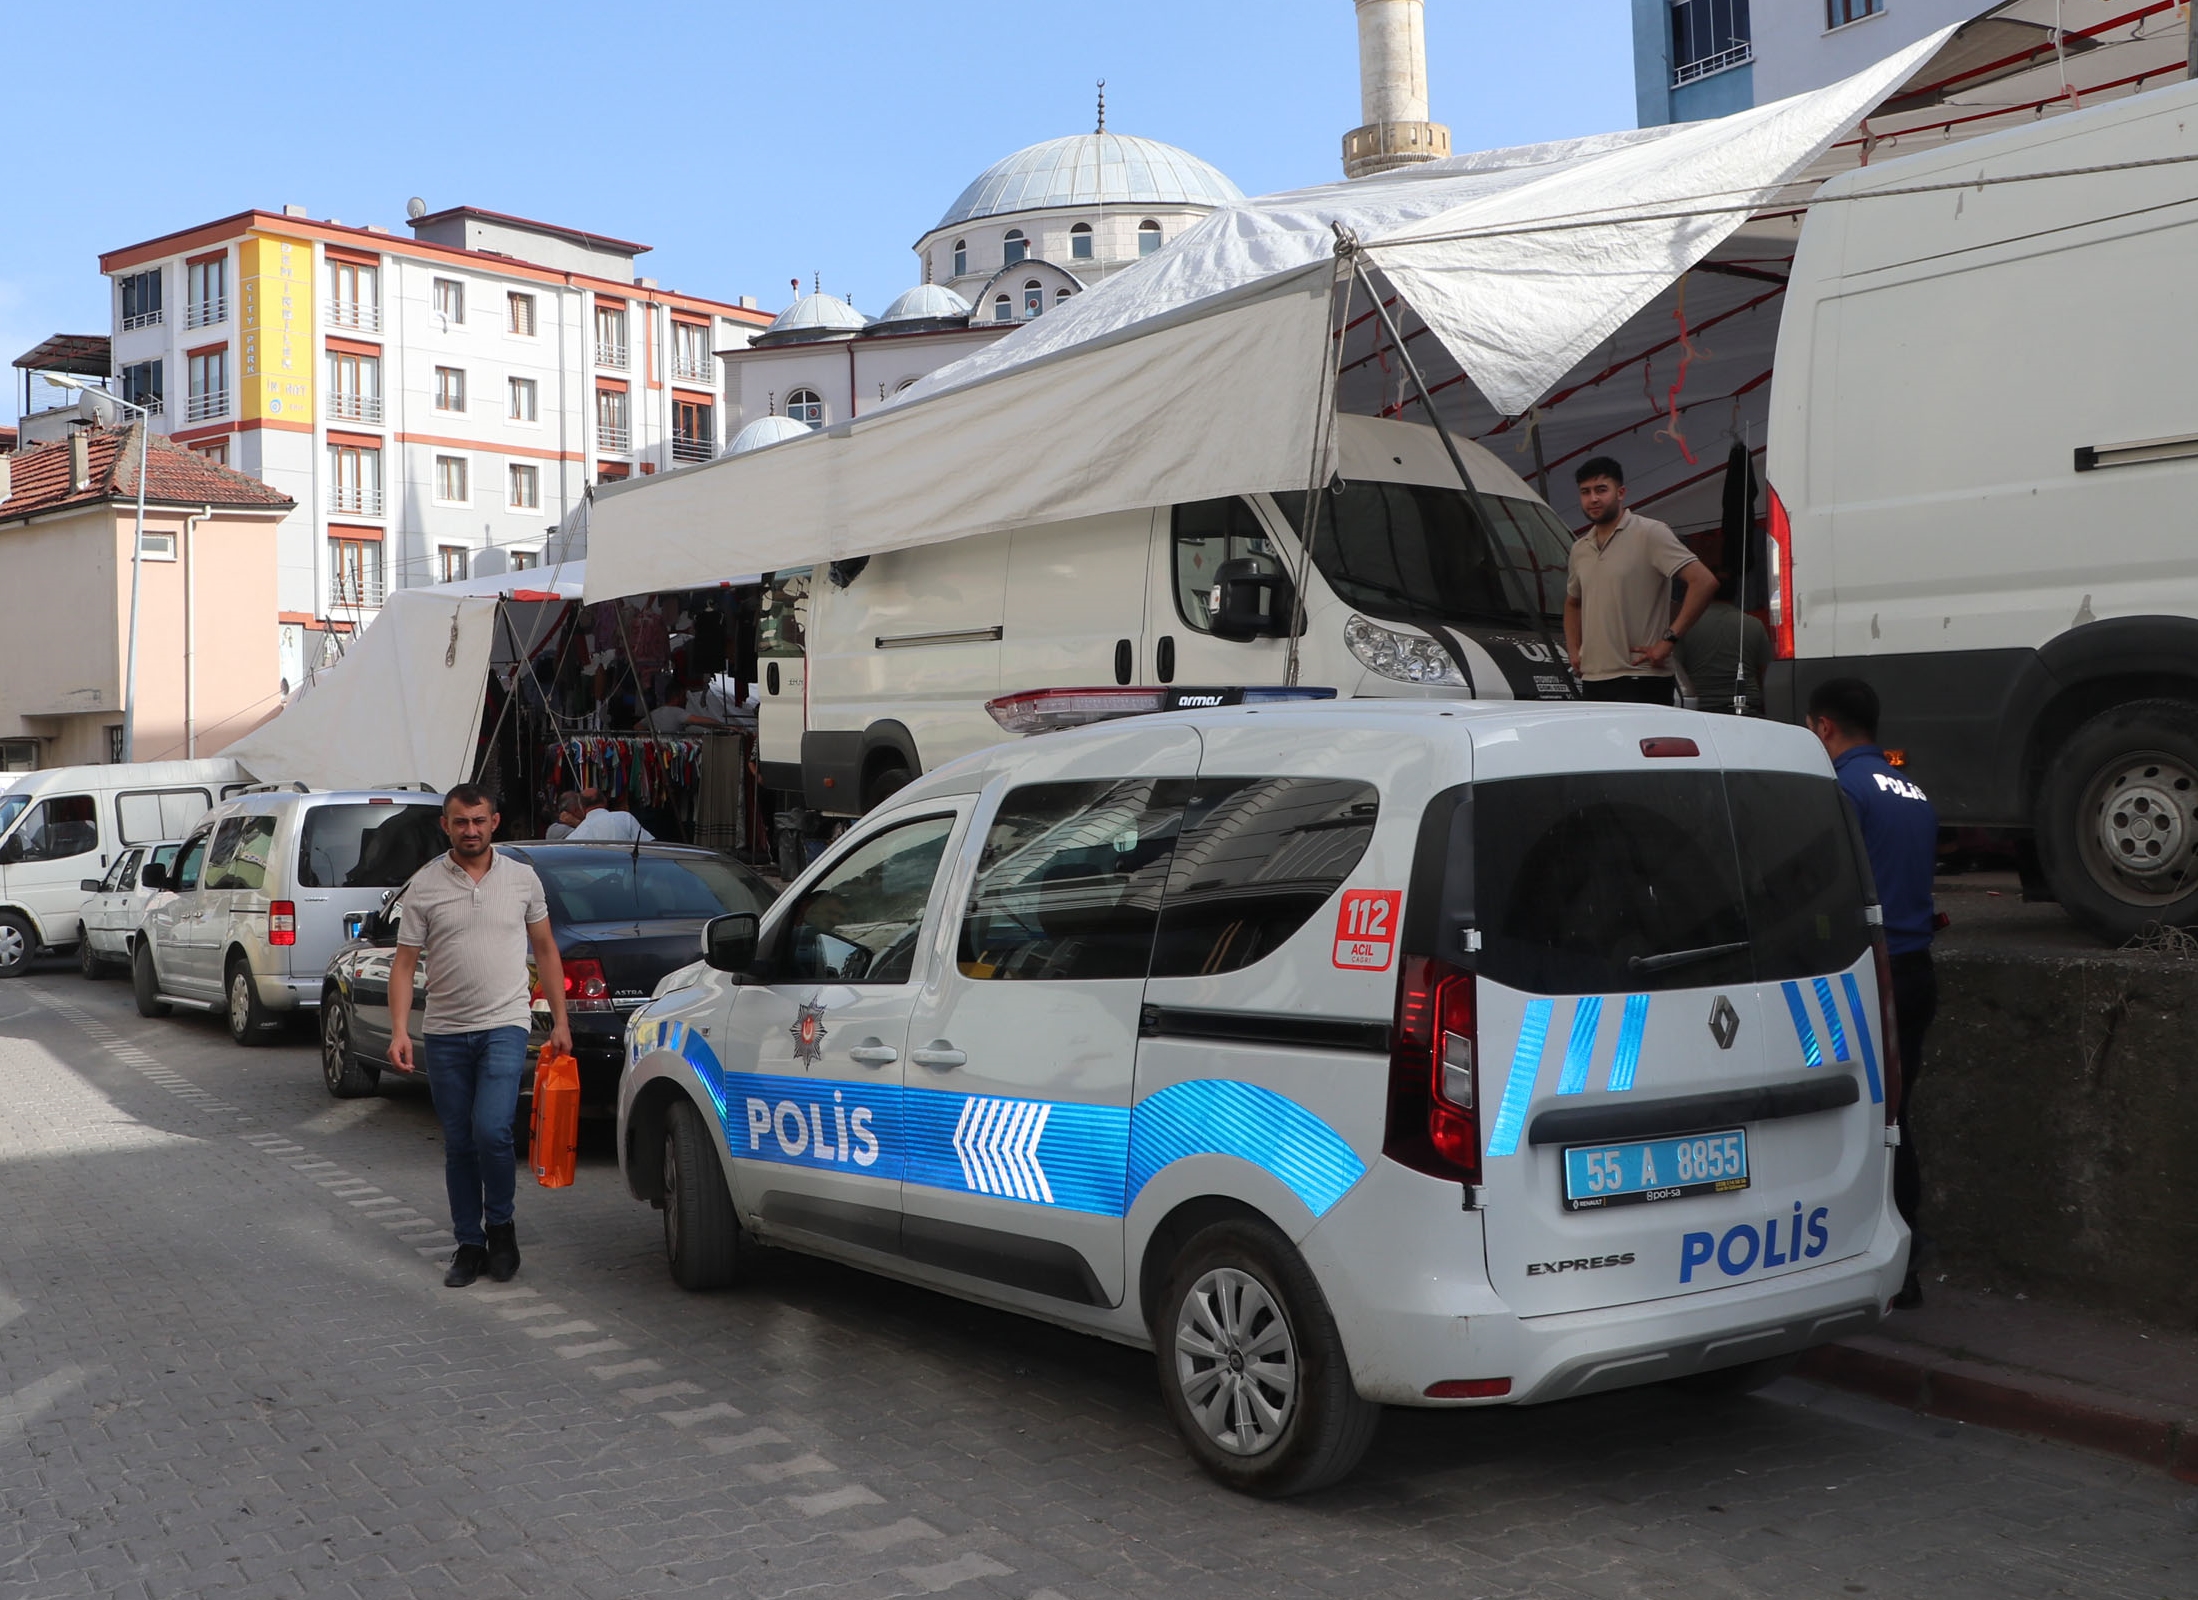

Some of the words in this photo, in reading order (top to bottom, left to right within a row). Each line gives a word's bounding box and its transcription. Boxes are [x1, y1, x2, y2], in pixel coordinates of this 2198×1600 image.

[246, 335, 255, 373] PARK
[1178, 696, 1223, 706] armas
[1872, 773, 1927, 801] POLİS
[1347, 899, 1390, 936] 112
[746, 1089, 879, 1167] POLİS
[1586, 1151, 1622, 1191] 55
[1641, 1147, 1658, 1186] A
[1678, 1137, 1740, 1180] 8855
[1580, 1199, 1602, 1207] RENAULT
[1679, 1200, 1829, 1284] POLİS
[1527, 1252, 1635, 1276] EXPRESS
